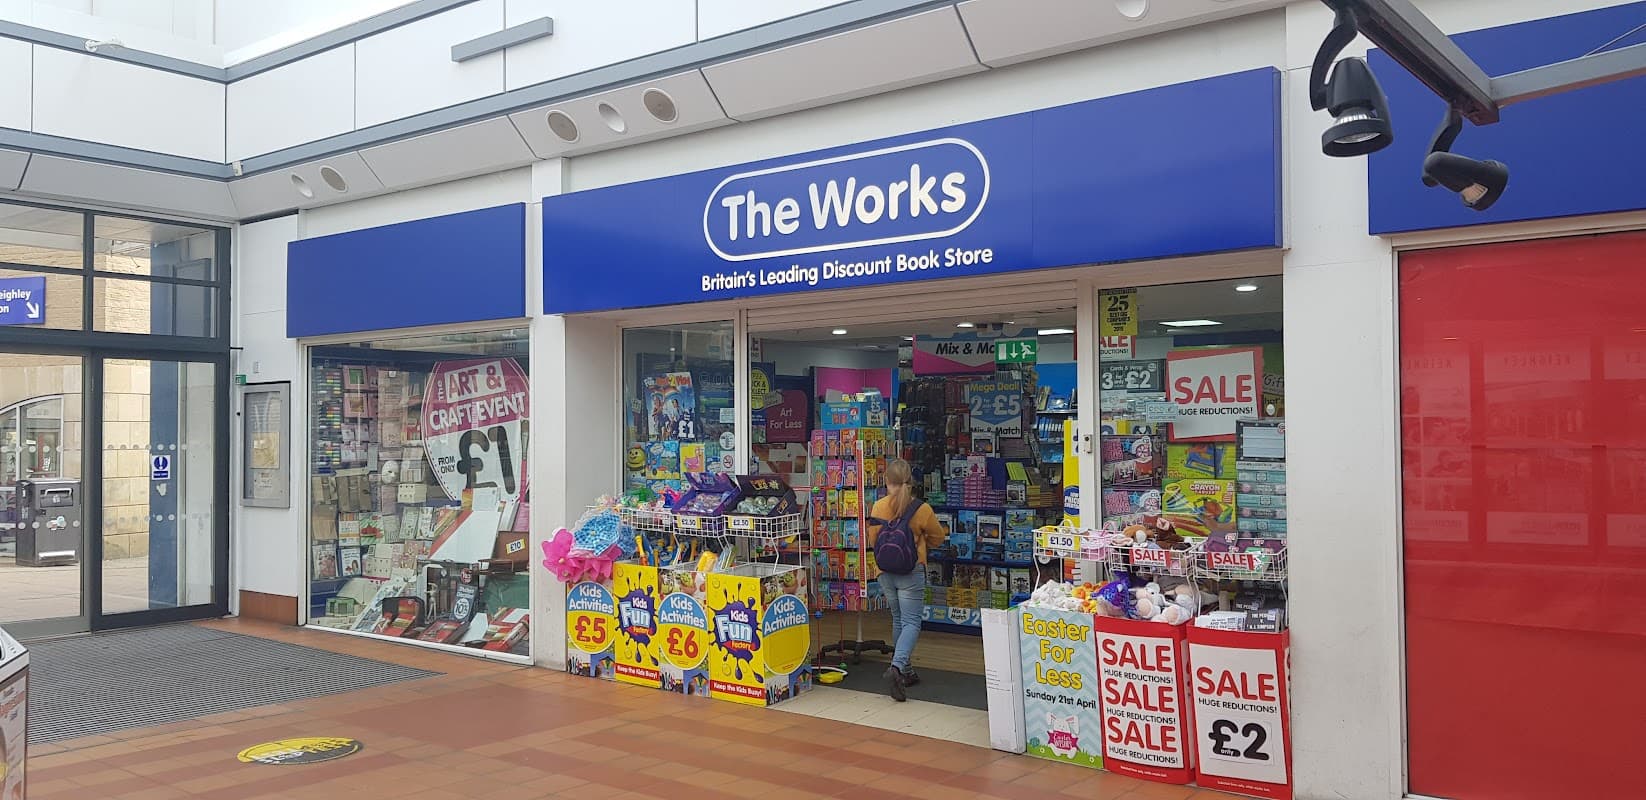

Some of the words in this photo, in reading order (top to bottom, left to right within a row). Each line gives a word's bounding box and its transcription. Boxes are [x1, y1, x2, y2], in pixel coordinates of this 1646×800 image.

[722, 190, 800, 241] The
[808, 163, 967, 230] Works
[702, 270, 756, 292] Britain's
[759, 264, 818, 286] Leading
[823, 256, 892, 280] Discount
[896, 249, 940, 272] Book
[944, 247, 993, 269] Store
[0, 289, 31, 302] eighley
[1108, 295, 1128, 311] 25
[0, 305, 10, 313] on
[936, 342, 960, 354] Mix
[963, 342, 972, 354] &
[1100, 336, 1128, 348] ALE
[449, 368, 478, 398] ART
[486, 365, 502, 390] &
[1102, 372, 1114, 390] 3
[1124, 370, 1152, 389] £2
[1174, 374, 1252, 405] SALE
[430, 404, 472, 431] CRAFT
[476, 392, 526, 421] EVENT
[780, 408, 792, 416] Art
[970, 395, 983, 416] 2
[992, 394, 1020, 416] £5
[1200, 407, 1252, 416] REDUCTIONS!
[678, 420, 695, 438] £1
[770, 420, 784, 429] For
[785, 420, 802, 429] Less
[438, 456, 455, 466] FROM
[456, 425, 516, 494] £1
[681, 518, 696, 526] £2.50
[733, 518, 748, 526] £2.50
[510, 542, 522, 551] £10
[1050, 536, 1072, 546] £1.50
[1134, 551, 1166, 562] SALE
[1214, 553, 1248, 566] SALE
[580, 584, 602, 598] Kids
[568, 598, 614, 614] Activities
[632, 597, 648, 609] Kids
[670, 596, 693, 610] Kids
[774, 598, 795, 616] Kids
[620, 601, 651, 628] Fun
[660, 610, 704, 628] Activities
[730, 610, 748, 622] Kids
[575, 616, 606, 644] £5
[715, 614, 752, 643] Fun
[764, 612, 806, 636] Activities
[1022, 612, 1090, 642] Easter
[667, 627, 698, 658] £6
[1040, 639, 1074, 664] For
[1102, 638, 1172, 672] SALE
[616, 666, 628, 674] Keep
[628, 666, 636, 674] the
[636, 668, 646, 676] Kids
[646, 670, 658, 679] Busy!
[1035, 661, 1082, 690] Less
[1104, 668, 1122, 678] HUGE
[1124, 672, 1174, 684] REDUCTIONS!
[714, 682, 726, 691] Keep
[726, 684, 736, 692] the
[736, 685, 747, 694] Kids
[748, 687, 762, 698] Busy!
[1196, 666, 1276, 702] SALE
[1026, 688, 1056, 704] Sunday
[1058, 694, 1074, 705] 21st
[1076, 698, 1096, 710] April
[1104, 678, 1174, 713] SALE
[1198, 698, 1220, 708] HUGE
[1222, 701, 1278, 713] REDUCTIONS!
[1106, 707, 1125, 718] HUGE
[1126, 712, 1176, 724] REDUCTIONS!
[1108, 716, 1177, 752] SALE
[1208, 719, 1270, 760] £2
[1109, 746, 1128, 756] HUGE
[1129, 750, 1178, 764] REDUCTIONS!
